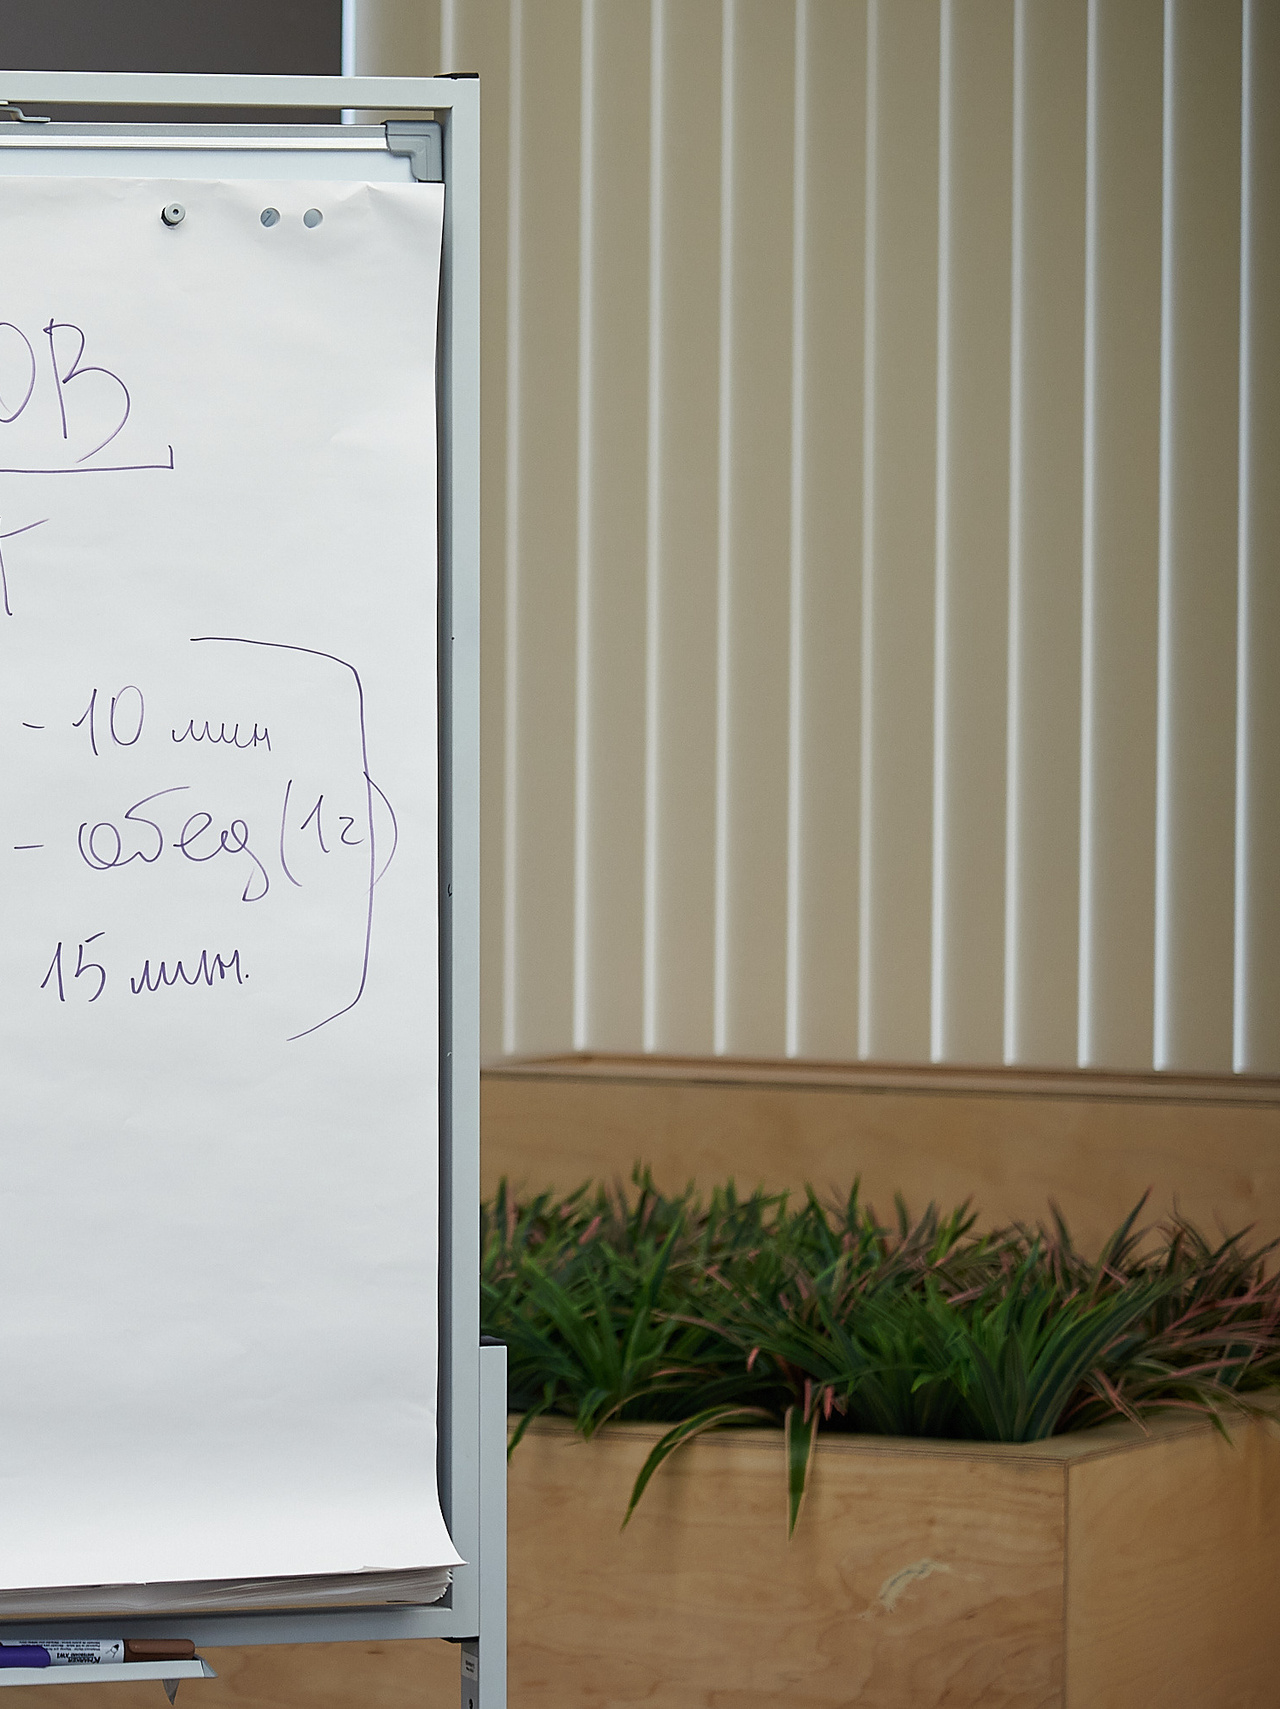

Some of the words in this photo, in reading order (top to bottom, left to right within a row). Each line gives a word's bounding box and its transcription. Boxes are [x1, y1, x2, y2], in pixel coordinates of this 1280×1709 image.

[71, 685, 145, 756] 10
[171, 719, 271, 752] мин
[78, 785, 270, 902] обед
[39, 931, 106, 1002] 15
[129, 948, 250, 994] мин.
